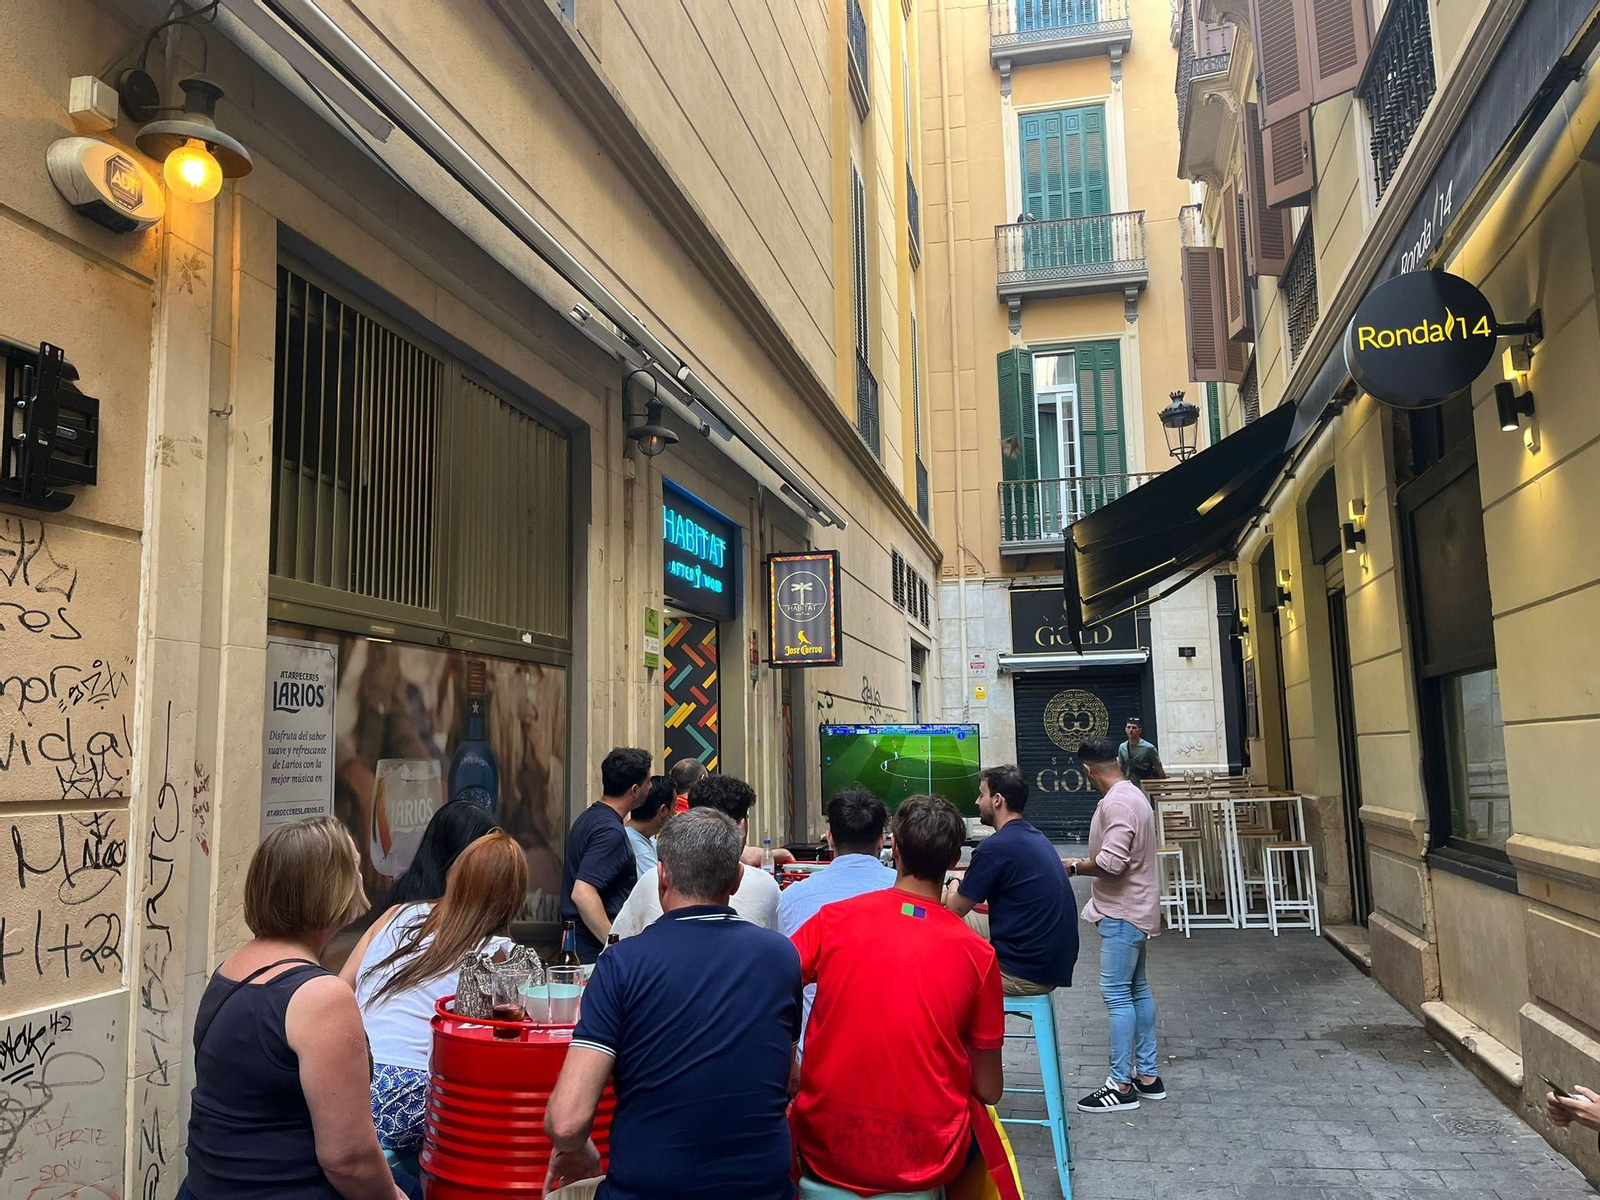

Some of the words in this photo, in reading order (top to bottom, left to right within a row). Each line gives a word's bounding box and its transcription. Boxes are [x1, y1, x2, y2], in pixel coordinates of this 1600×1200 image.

[1401, 217, 1432, 275] Ronda
[1440, 179, 1454, 227] 14
[1358, 318, 1445, 351] Ronda
[1456, 314, 1492, 340] 14
[662, 504, 726, 568] HABITAT
[787, 604, 817, 612] HABITAT
[784, 645, 800, 657] Jose
[800, 644, 823, 656] Cuervo
[273, 681, 326, 713] LARIOS
[269, 730, 297, 743] Disfruta
[298, 731, 308, 741] del
[309, 731, 327, 741] sabor
[268, 747, 287, 756] suave
[287, 748, 292, 757] y
[292, 745, 327, 757] refrescante
[272, 759, 281, 770] de
[281, 760, 303, 770] Larios
[303, 761, 315, 770] con
[315, 759, 322, 769] la
[270, 775, 291, 787] mejor
[291, 773, 314, 784] música
[315, 774, 323, 783] en
[1036, 768, 1098, 793] GOL
